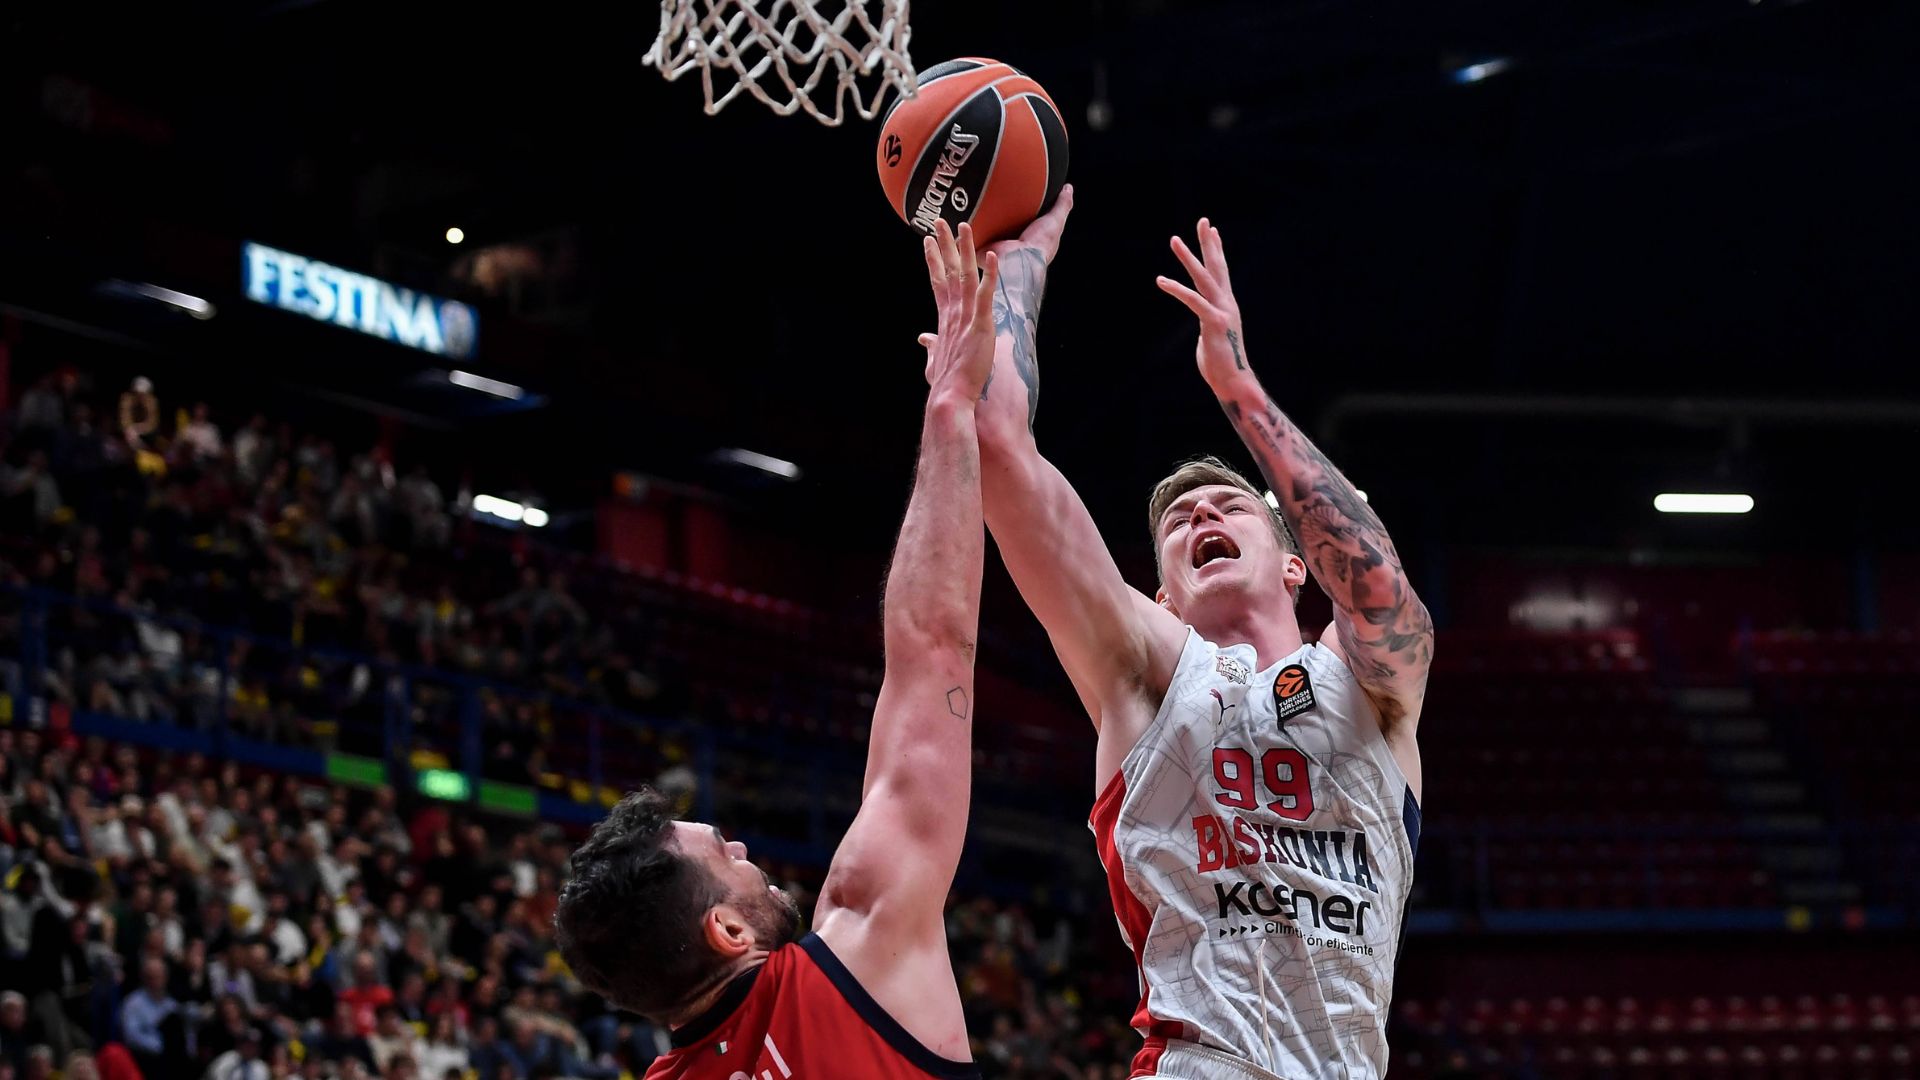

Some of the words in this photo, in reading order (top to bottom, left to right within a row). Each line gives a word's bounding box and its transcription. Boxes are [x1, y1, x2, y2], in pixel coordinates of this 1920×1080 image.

[247, 242, 445, 354] FESTINA
[1278, 689, 1310, 709] TURKISH
[1280, 695, 1312, 714] AIRLINES
[1212, 746, 1315, 822] 99
[1326, 938, 1374, 957] eficiente
